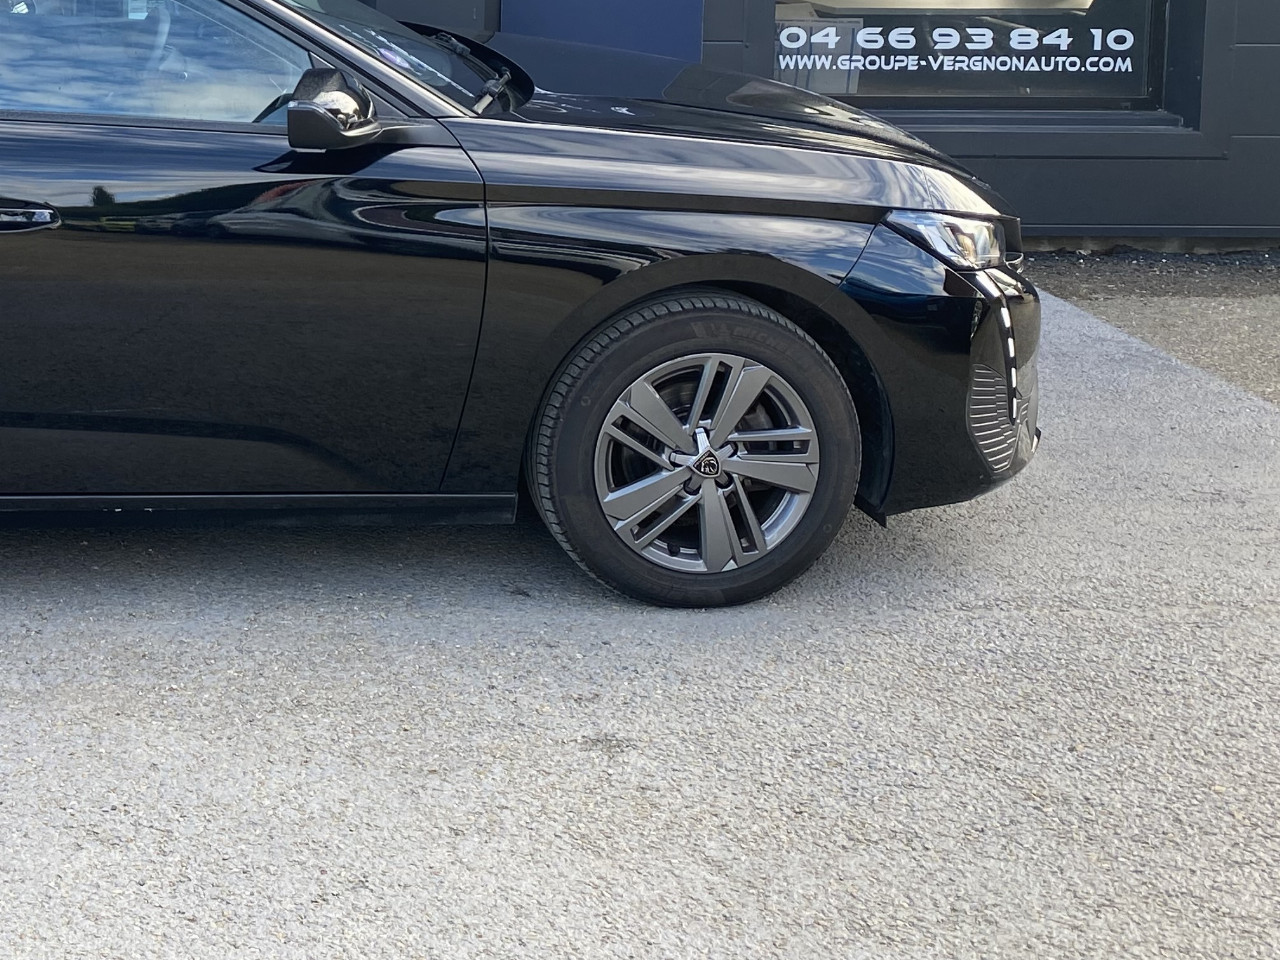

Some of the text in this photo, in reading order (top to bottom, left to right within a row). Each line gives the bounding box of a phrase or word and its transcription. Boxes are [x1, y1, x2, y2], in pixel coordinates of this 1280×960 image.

[779, 27, 1134, 50] 04 66 93 84 10
[778, 54, 1133, 72] WWW.GROUPE-VERGNONAUTO.COM
